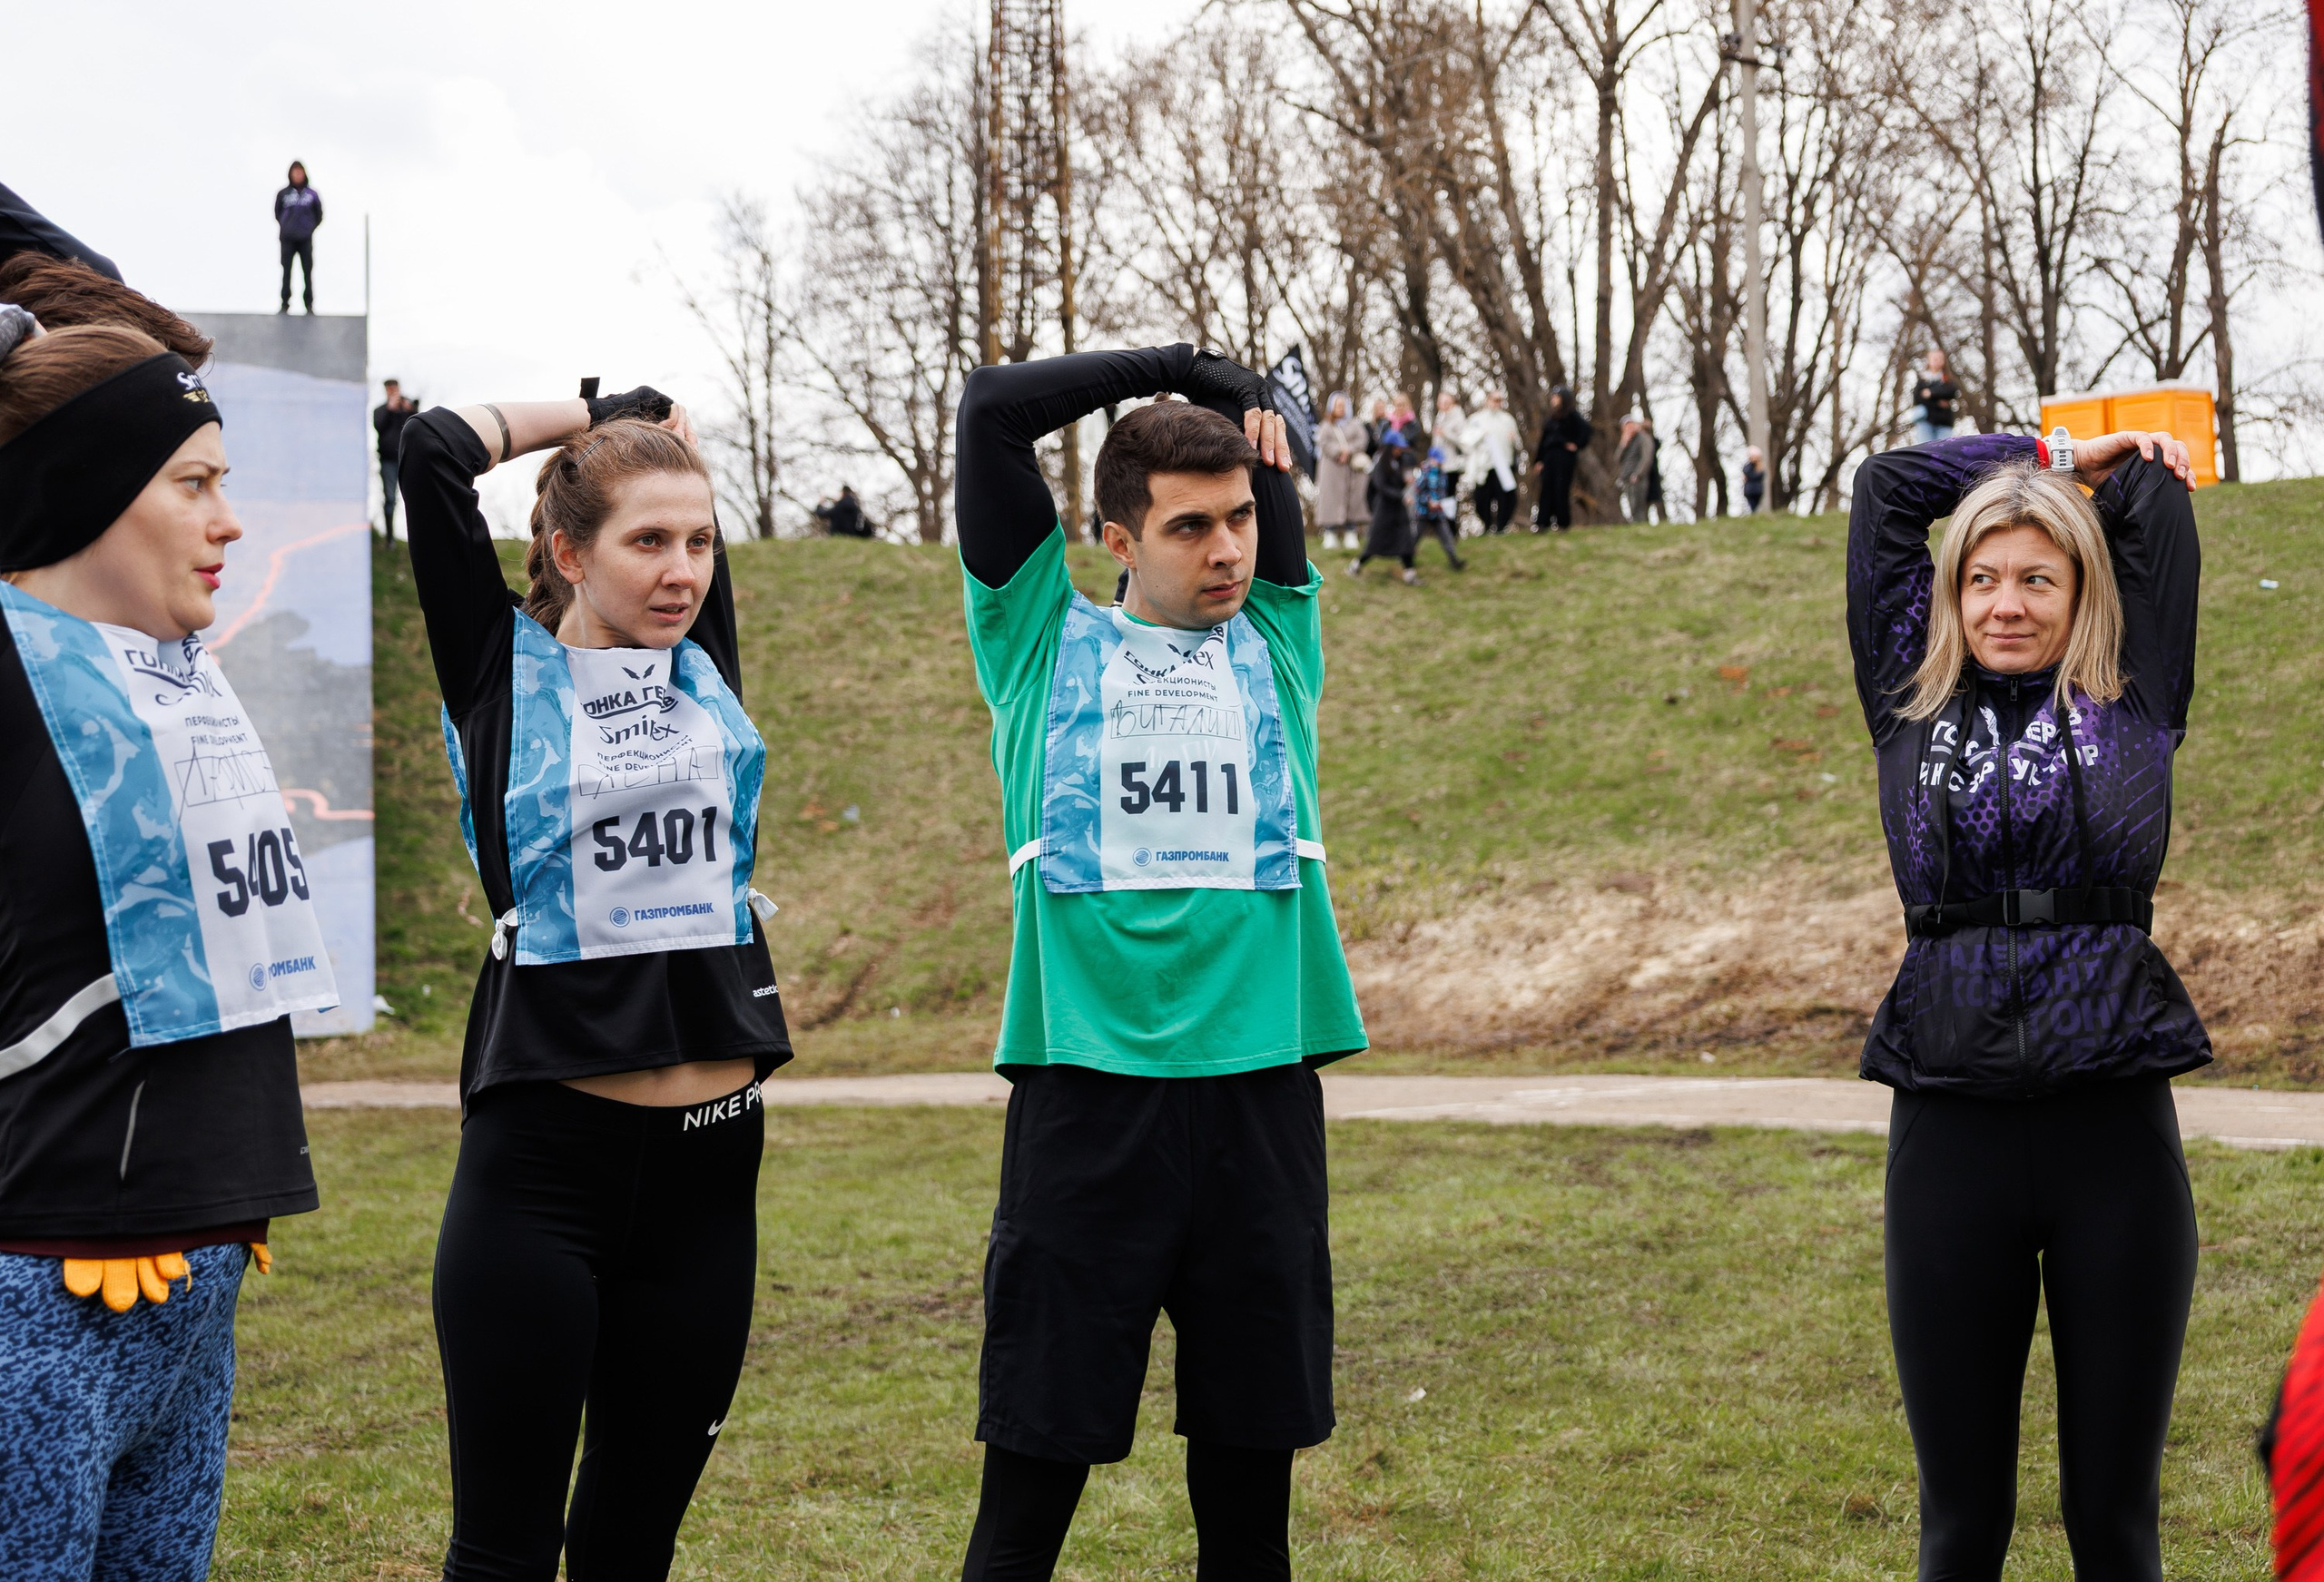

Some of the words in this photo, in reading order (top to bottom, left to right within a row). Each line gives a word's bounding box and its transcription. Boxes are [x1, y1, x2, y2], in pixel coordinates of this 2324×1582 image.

[581, 690, 637, 715] ОНКА
[1128, 689, 1150, 698] FINE
[1155, 689, 1218, 703] DEVELOPMENT
[1120, 760, 1238, 815] 5411
[592, 806, 717, 872] 5401
[1156, 850, 1229, 862] ГАЗПРОМБАНК
[207, 827, 310, 918] 5405
[634, 902, 714, 921] ГАЗПРОМБАНК
[683, 1094, 742, 1132] NIKE
[746, 1080, 763, 1110] PR
